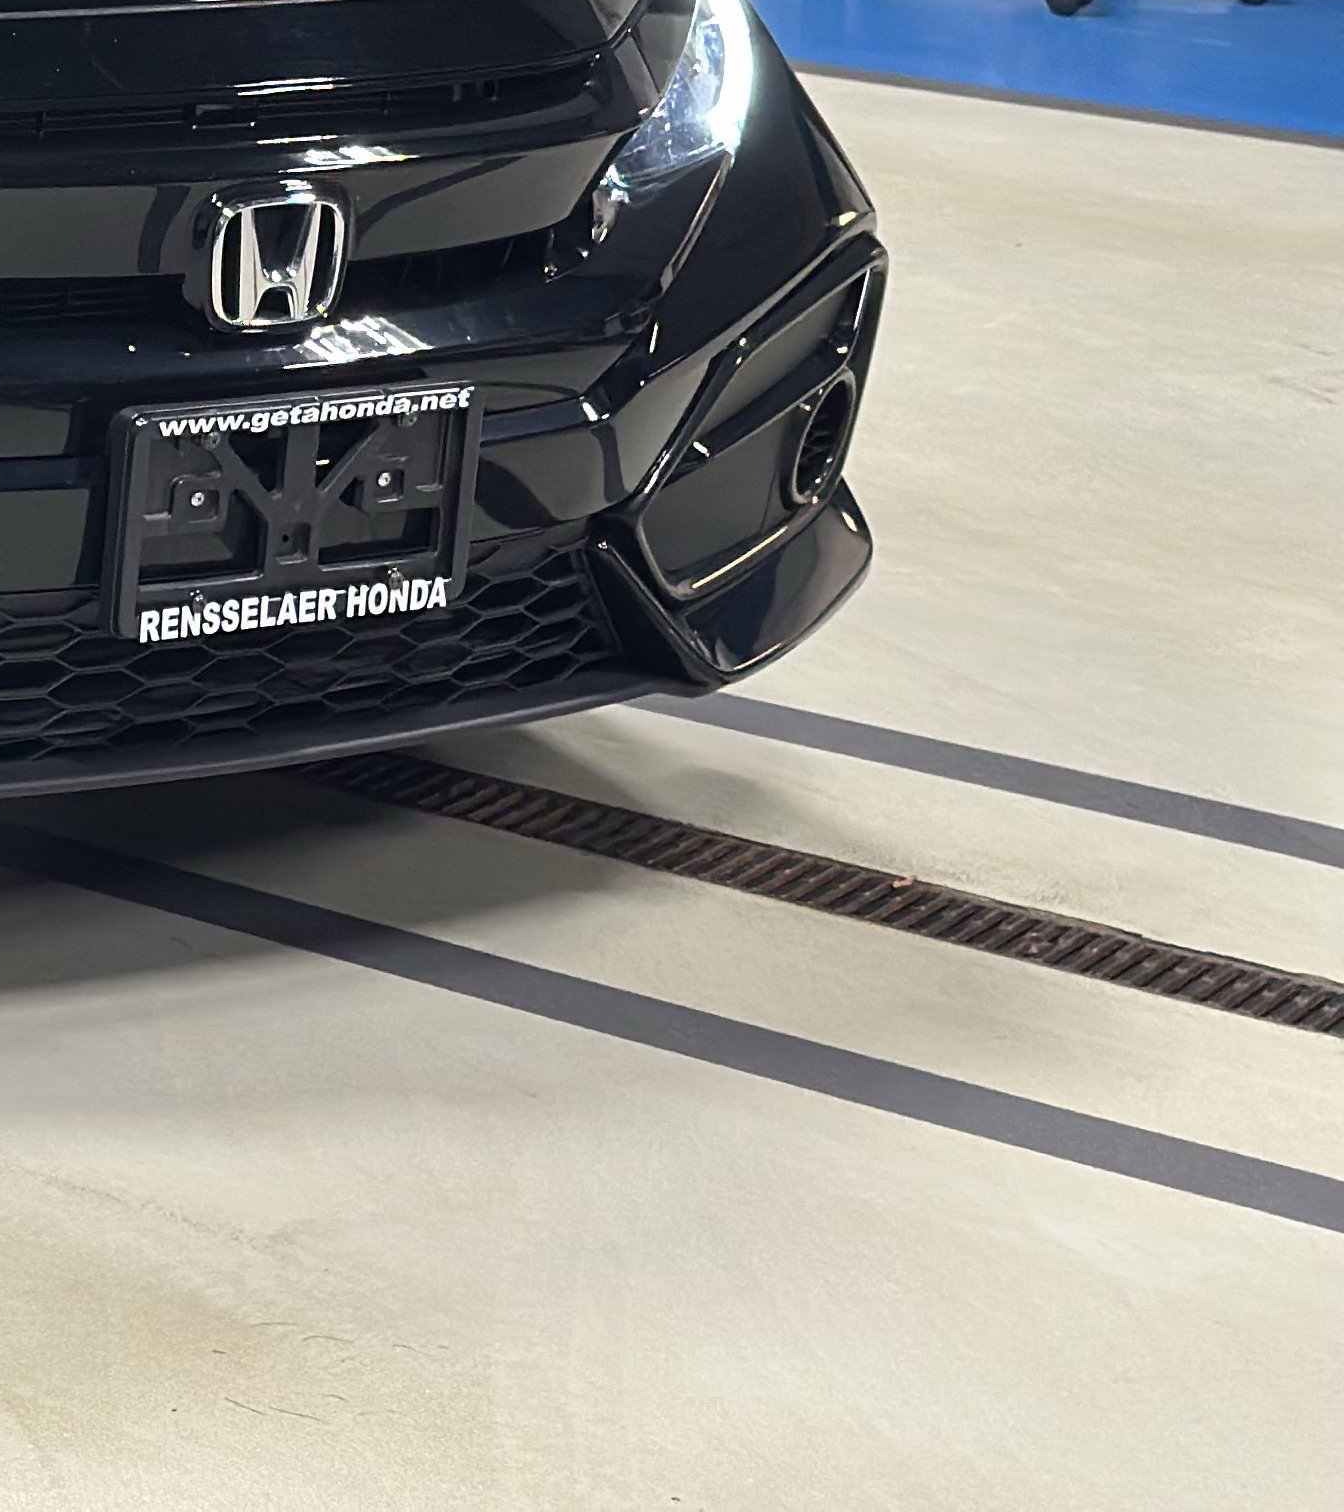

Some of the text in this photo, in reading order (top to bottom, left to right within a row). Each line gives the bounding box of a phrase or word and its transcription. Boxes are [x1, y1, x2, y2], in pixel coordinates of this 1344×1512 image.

[160, 386, 475, 437] www.getahonda.net
[139, 577, 448, 643] RENSSELAER HONDA
